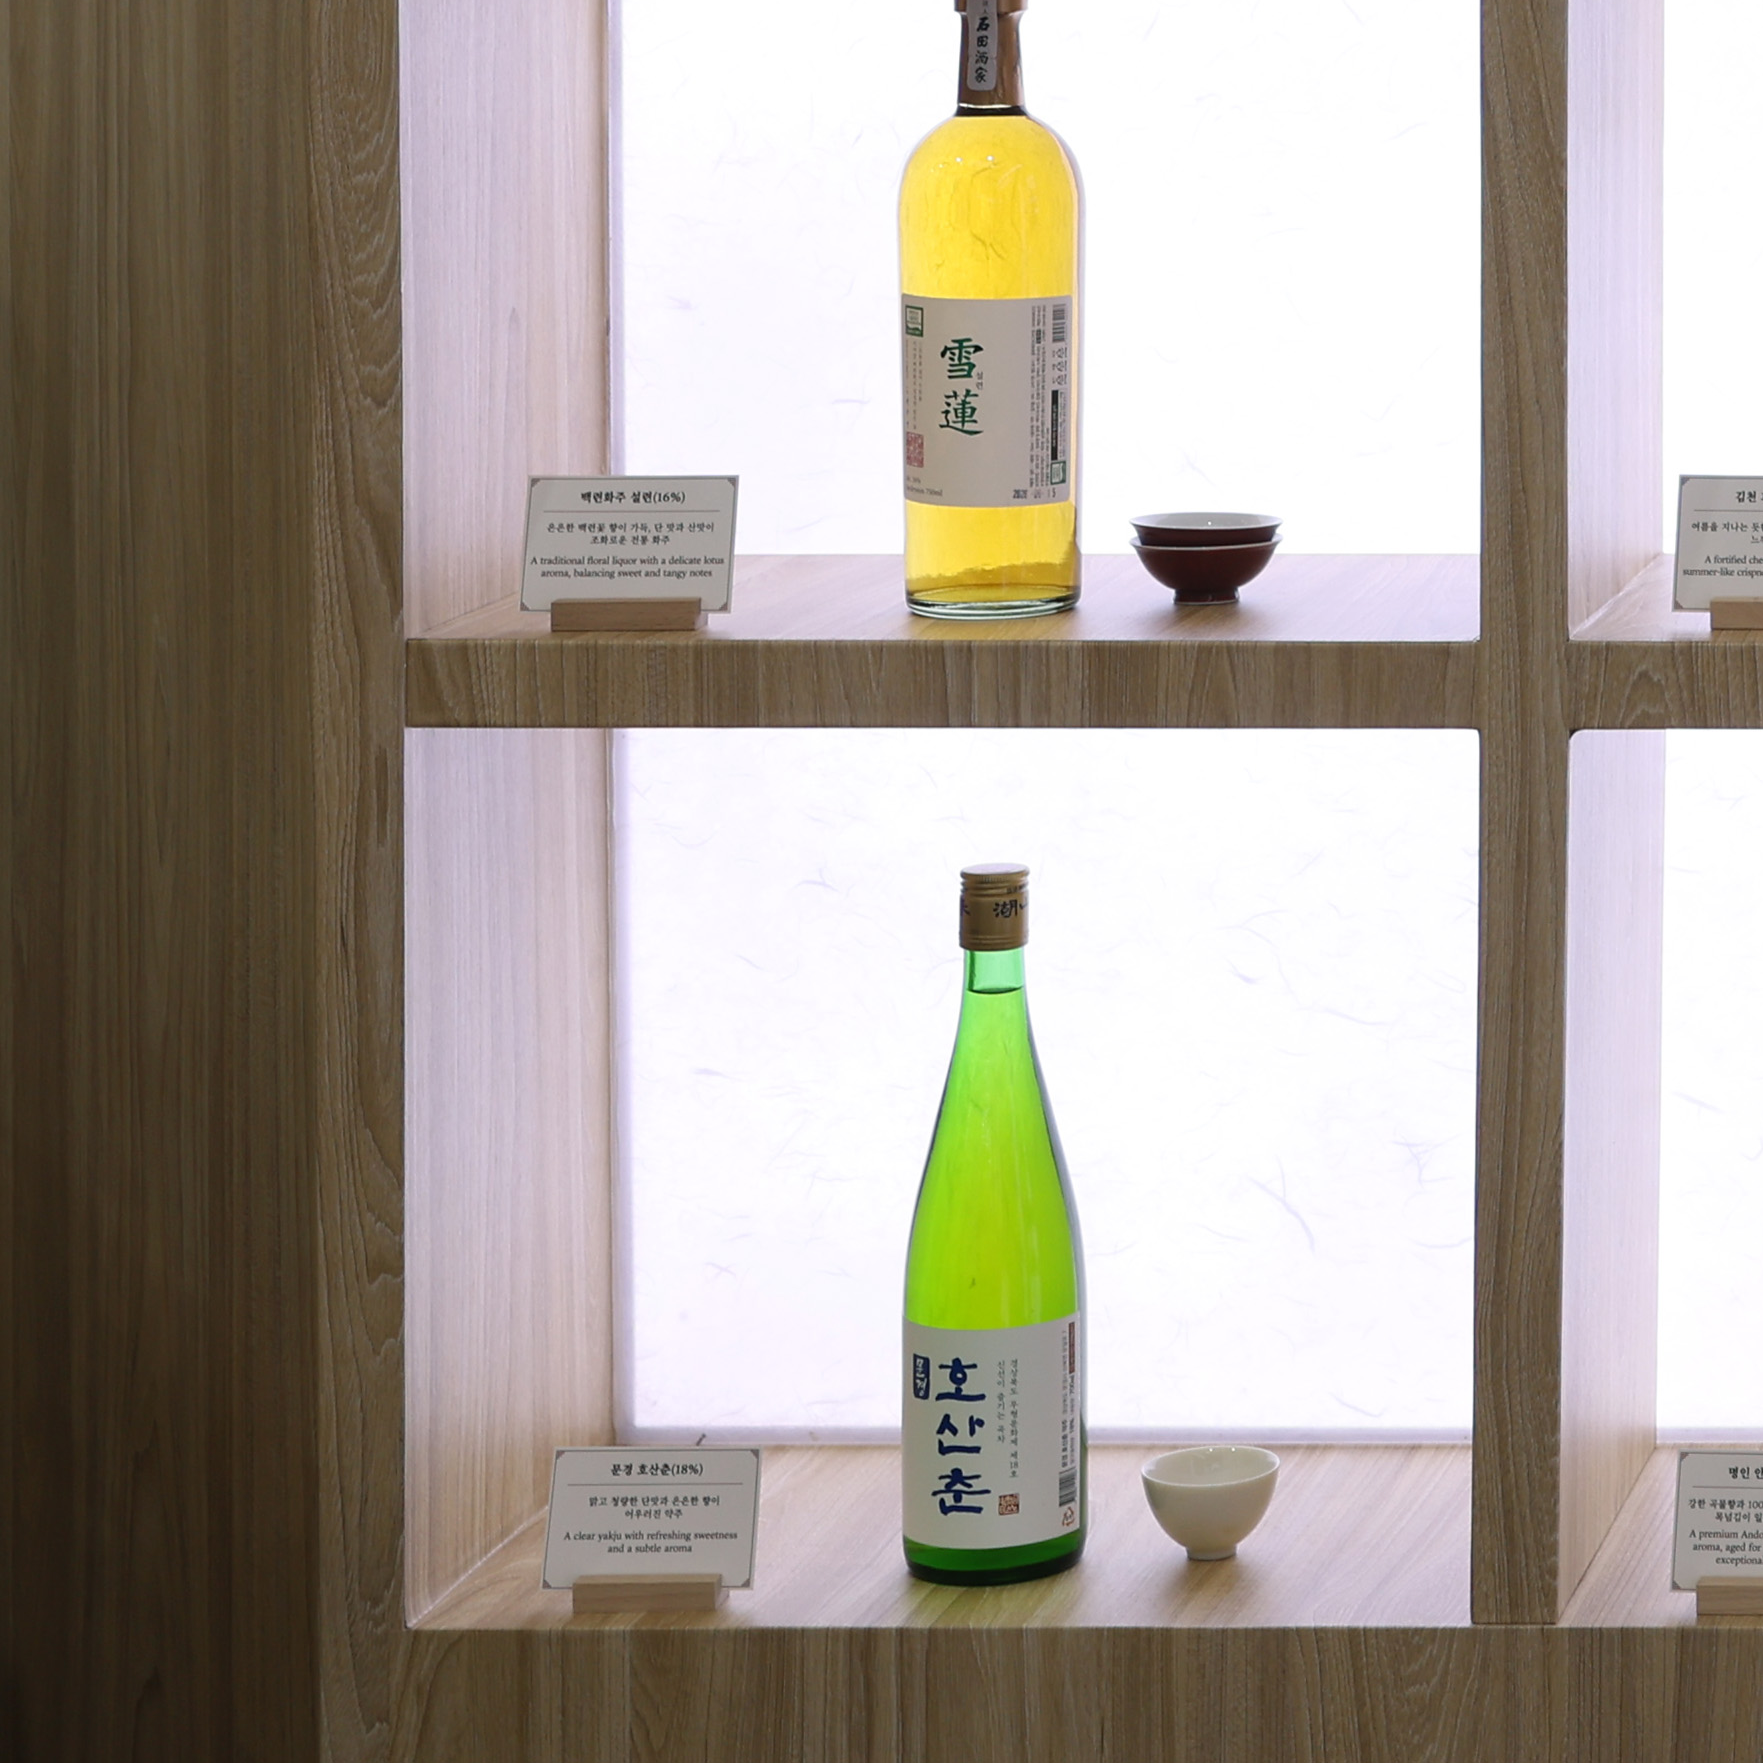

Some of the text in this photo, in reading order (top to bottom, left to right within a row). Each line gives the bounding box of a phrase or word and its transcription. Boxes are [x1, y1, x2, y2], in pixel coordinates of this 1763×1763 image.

[938, 337, 985, 437] 雪蓮
[580, 490, 626, 504] 백련화주
[1736, 490, 1756, 503] 김천
[540, 567, 712, 580] aroma, balancing sweet and tangy notes
[1682, 567, 1735, 576] summer-like
[931, 1356, 992, 1517] 호산춘
[610, 1463, 633, 1476] 문경
[1728, 1466, 1750, 1479] 명인
[573, 1530, 595, 1541] clear
[597, 1530, 622, 1542] yakju
[624, 1530, 644, 1540] with
[646, 1530, 691, 1542] refreshing
[693, 1531, 737, 1540] sweetness
